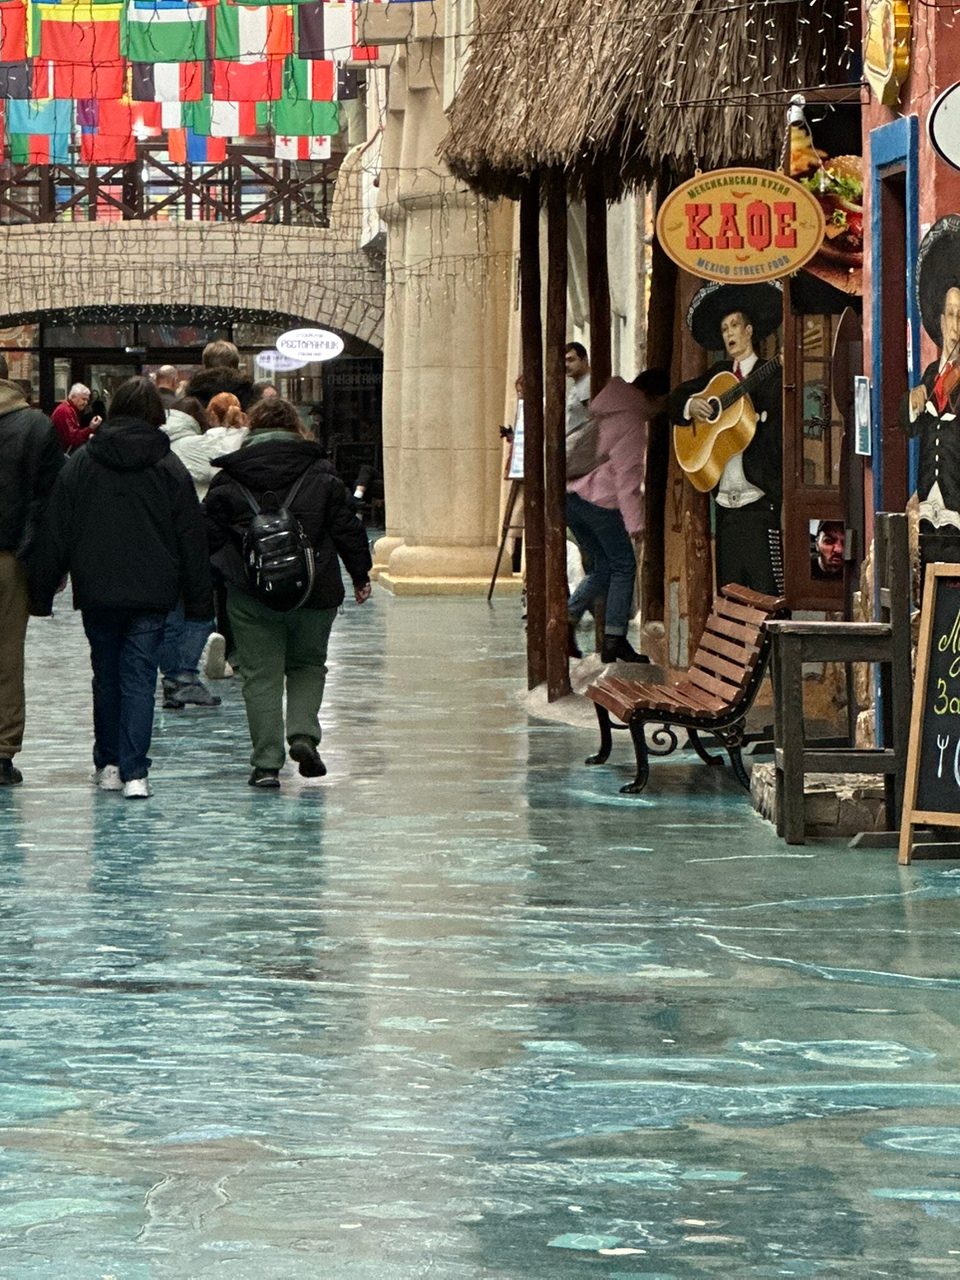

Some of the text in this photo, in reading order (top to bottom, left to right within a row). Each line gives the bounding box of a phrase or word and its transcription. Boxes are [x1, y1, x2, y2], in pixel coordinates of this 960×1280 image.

[687, 175, 791, 199] МЕКСИКАНСКАЯ КУХНЯ
[685, 199, 797, 252] КАФЕ
[696, 255, 790, 276] MEXICO STREET FOOD
